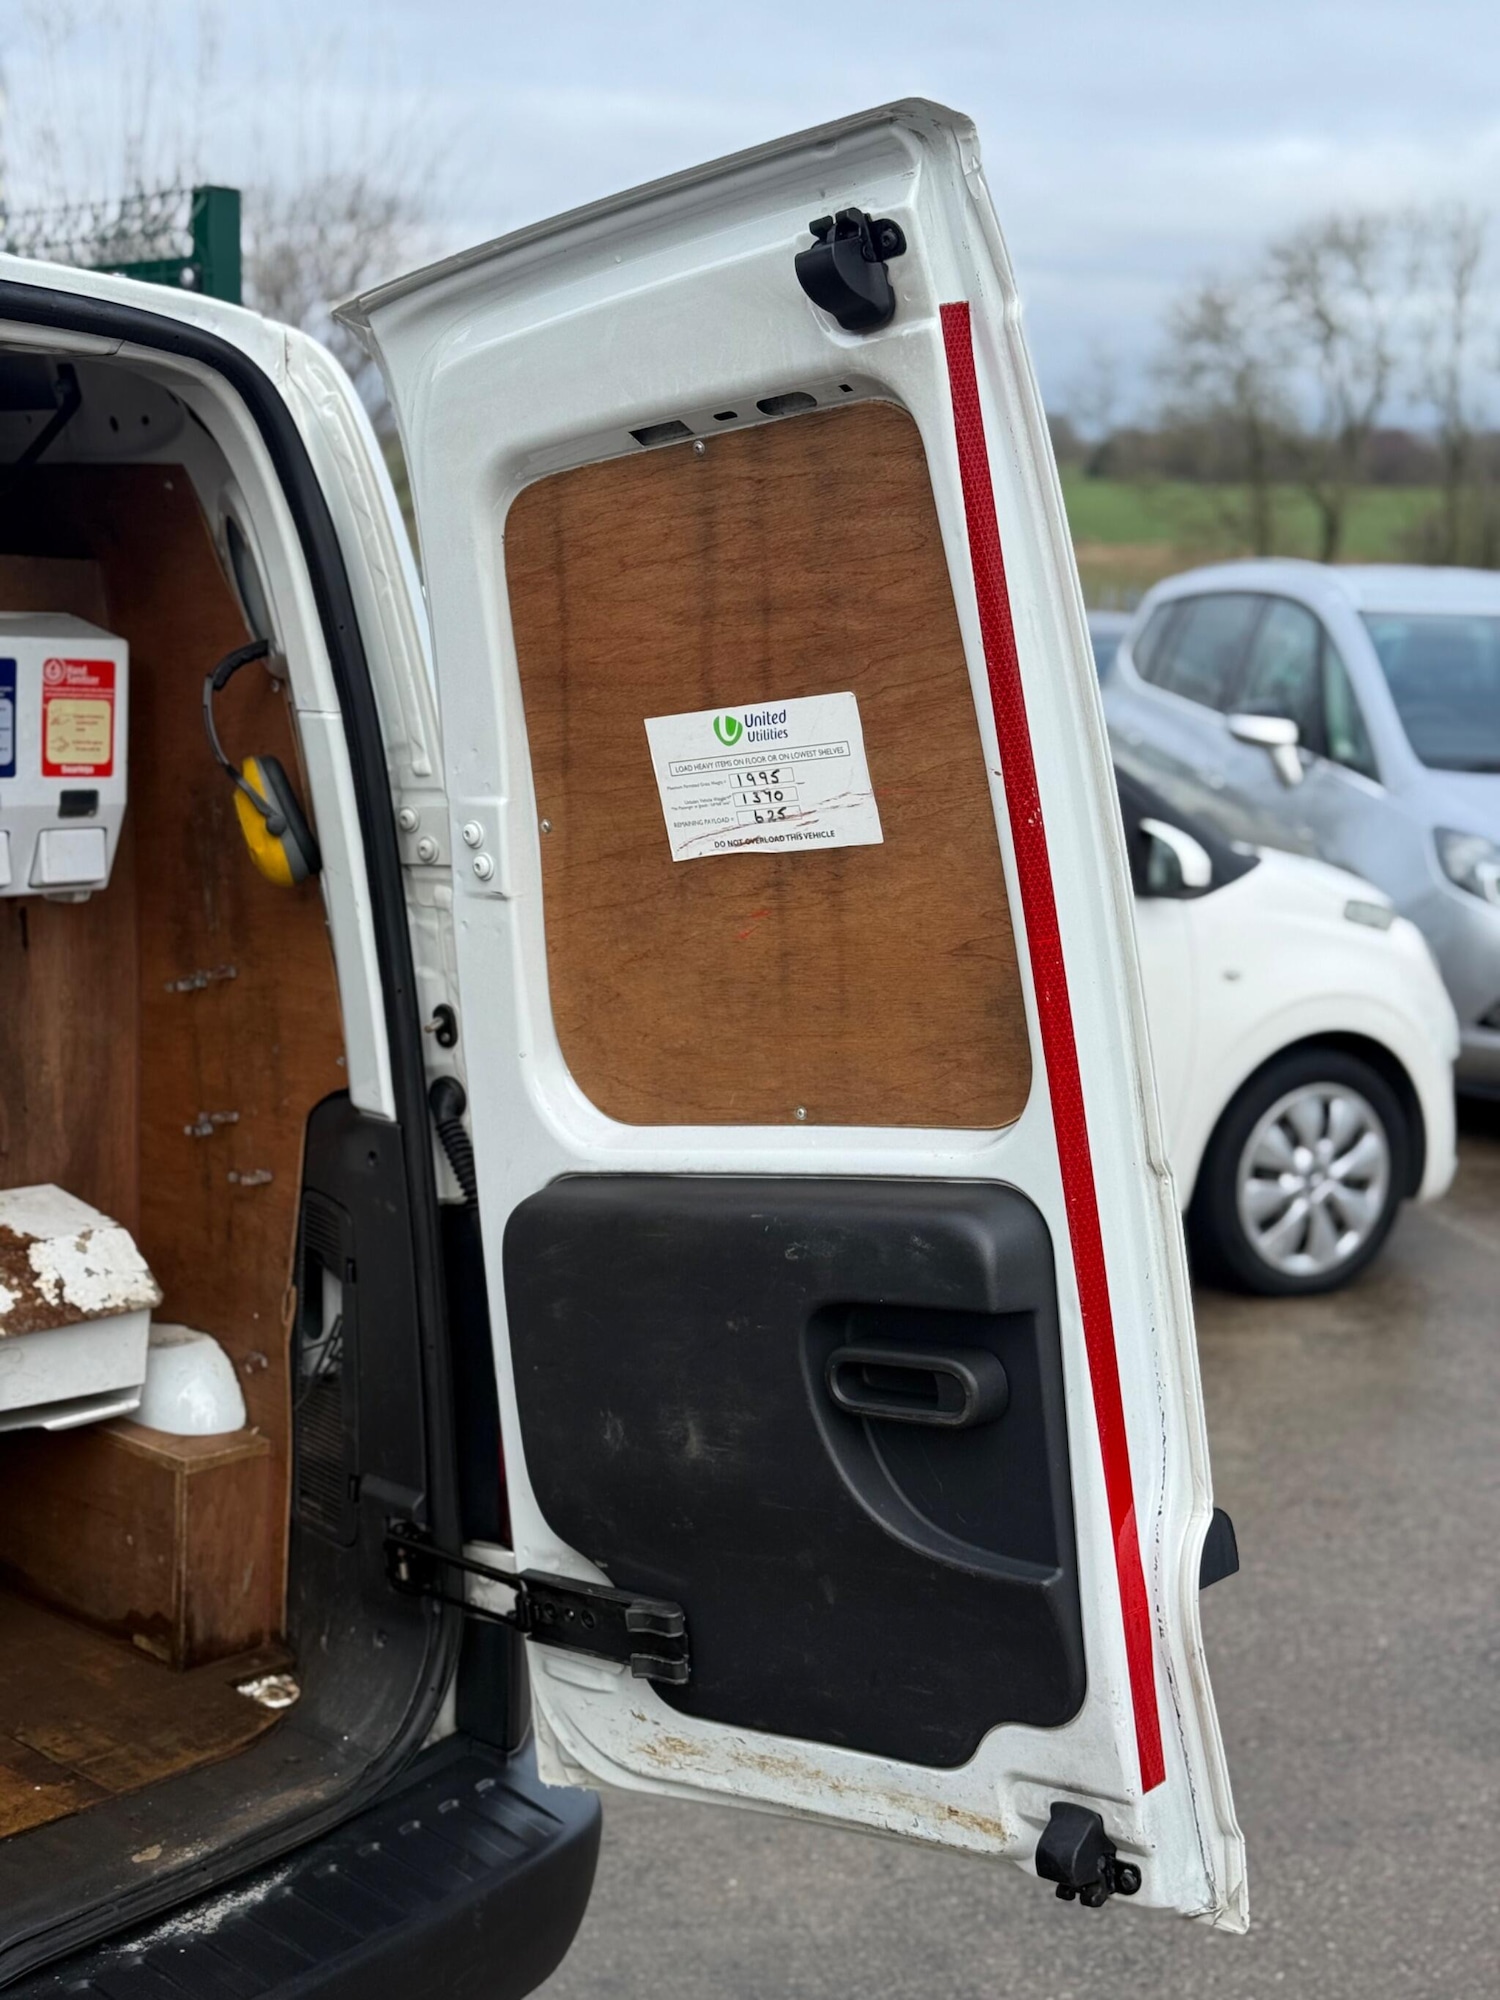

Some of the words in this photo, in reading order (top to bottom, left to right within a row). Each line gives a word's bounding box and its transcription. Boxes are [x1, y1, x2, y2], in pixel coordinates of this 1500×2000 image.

[744, 709, 787, 728] United
[747, 727, 789, 743] Utilities
[675, 765, 693, 774] LOAD
[694, 762, 714, 771] HEAVY
[715, 760, 732, 768] ITEMS
[733, 758, 745, 766] ON
[745, 756, 767, 765] FLOOR
[767, 754, 778, 762] OR
[778, 752, 790, 761] ON
[791, 749, 817, 759] LOWEST
[818, 746, 845, 756] SHELVES
[737, 768, 780, 788] 1995
[673, 819, 703, 828] REMAINING
[704, 816, 730, 825] PAYLOAD
[753, 805, 787, 824] 625
[714, 840, 726, 849] DO
[727, 838, 743, 848] NOT
[744, 834, 785, 846] OVERLOAD
[786, 831, 804, 842] THIS
[804, 829, 836, 841] VEHICLE
